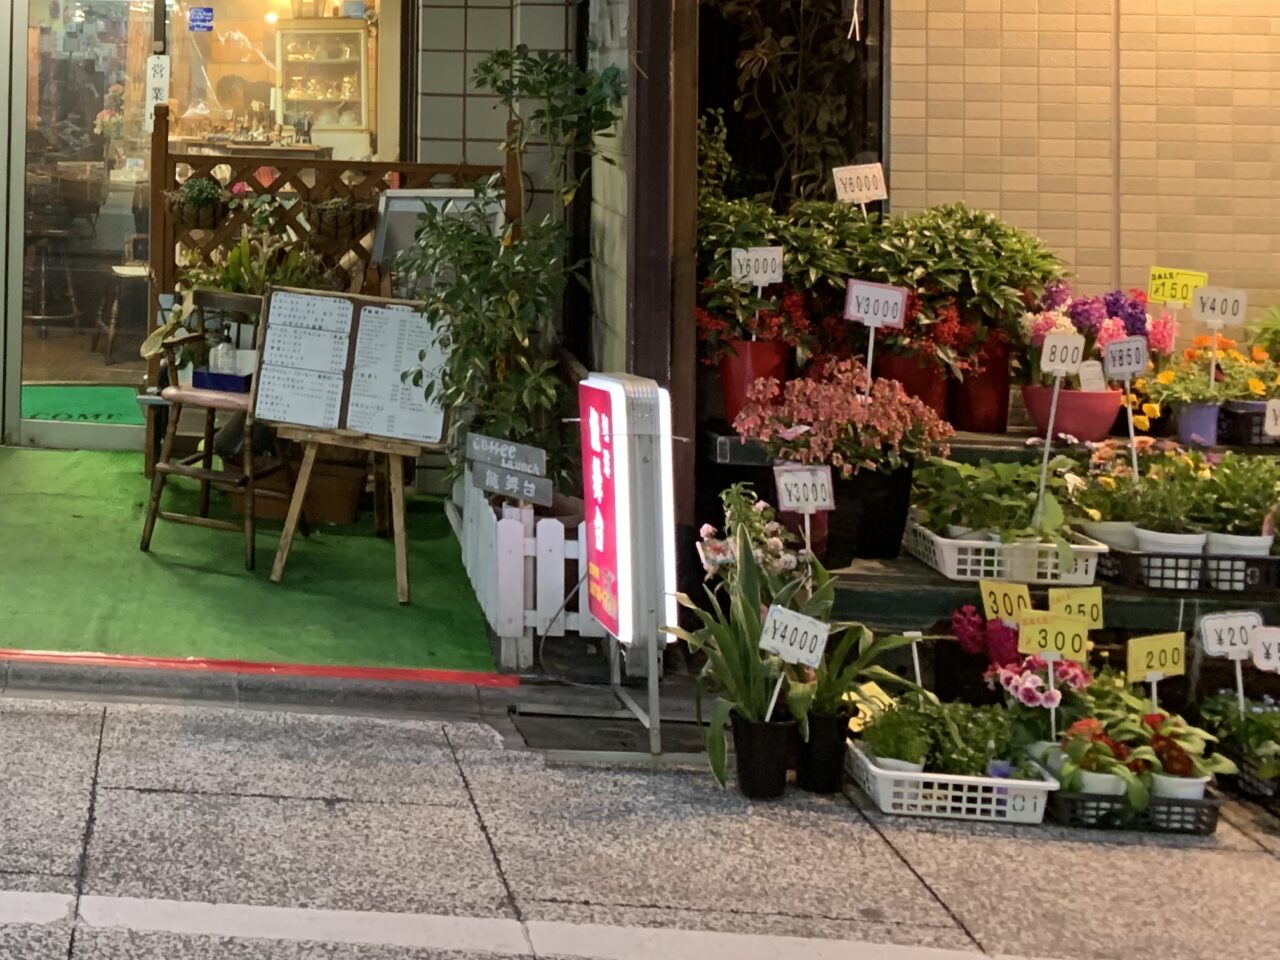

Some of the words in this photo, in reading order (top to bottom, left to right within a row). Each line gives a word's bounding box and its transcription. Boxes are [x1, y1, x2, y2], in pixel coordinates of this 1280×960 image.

[1049, 344, 1080, 365] 800
[1215, 625, 1256, 647] ¥20
[1146, 647, 1180, 669] 200
